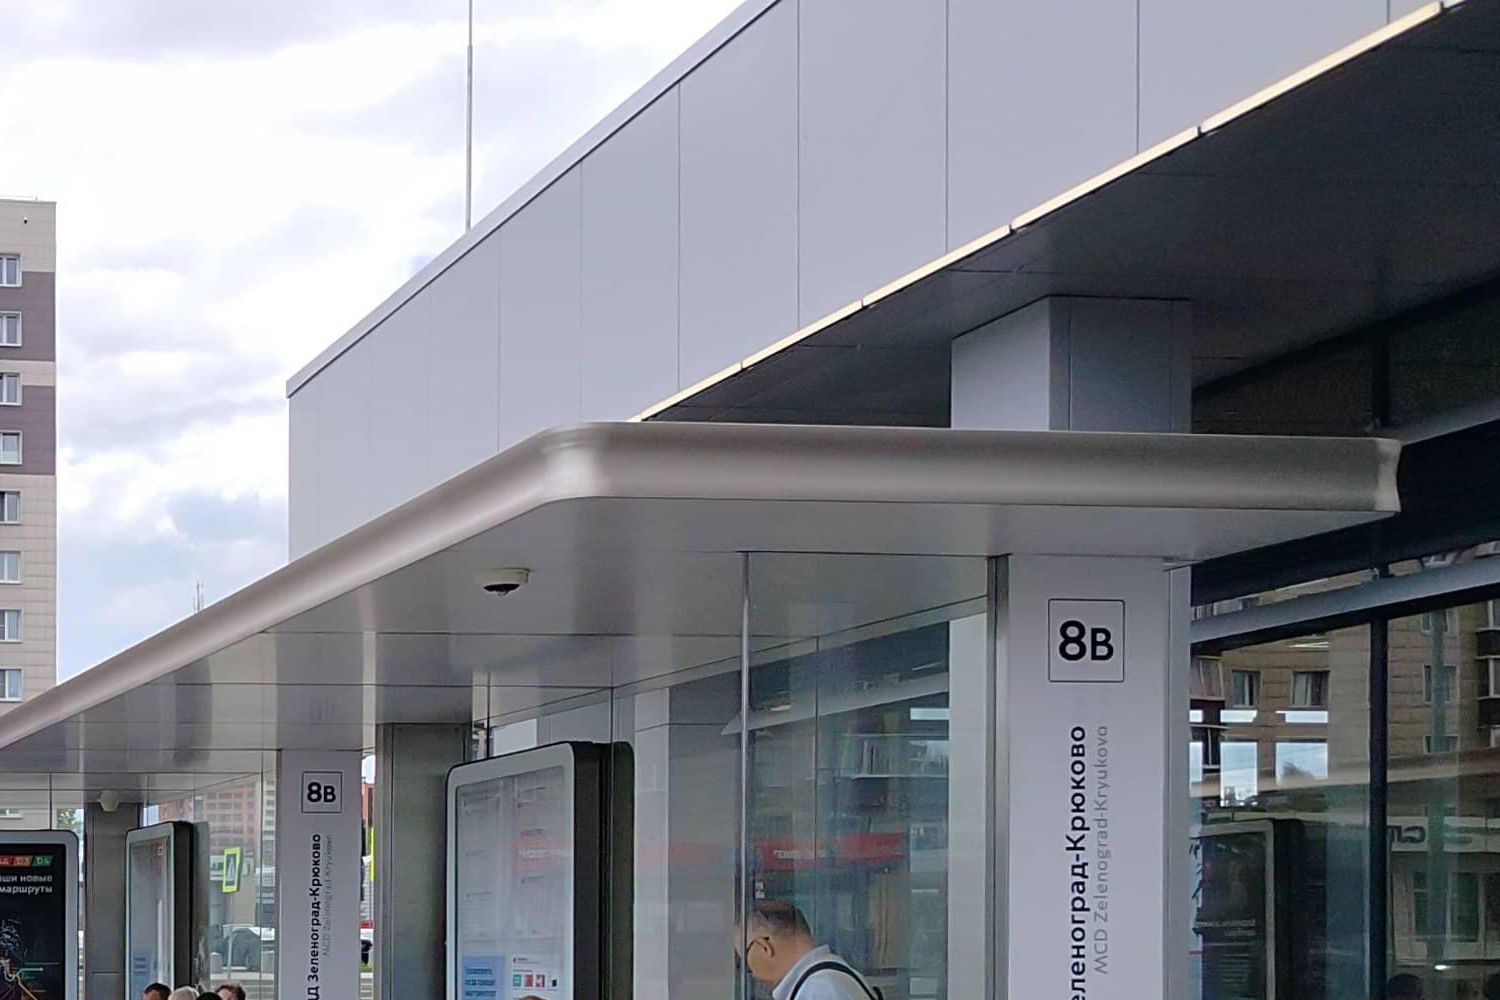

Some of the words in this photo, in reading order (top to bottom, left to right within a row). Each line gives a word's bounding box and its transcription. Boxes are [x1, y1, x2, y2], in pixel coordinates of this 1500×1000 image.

[1092, 725, 1112, 923] Zelenograd-Kryukovo
[20, 874, 53, 882] новые
[307, 833, 323, 983] Зеленоград-Крюково
[1093, 928, 1109, 975] MCD
